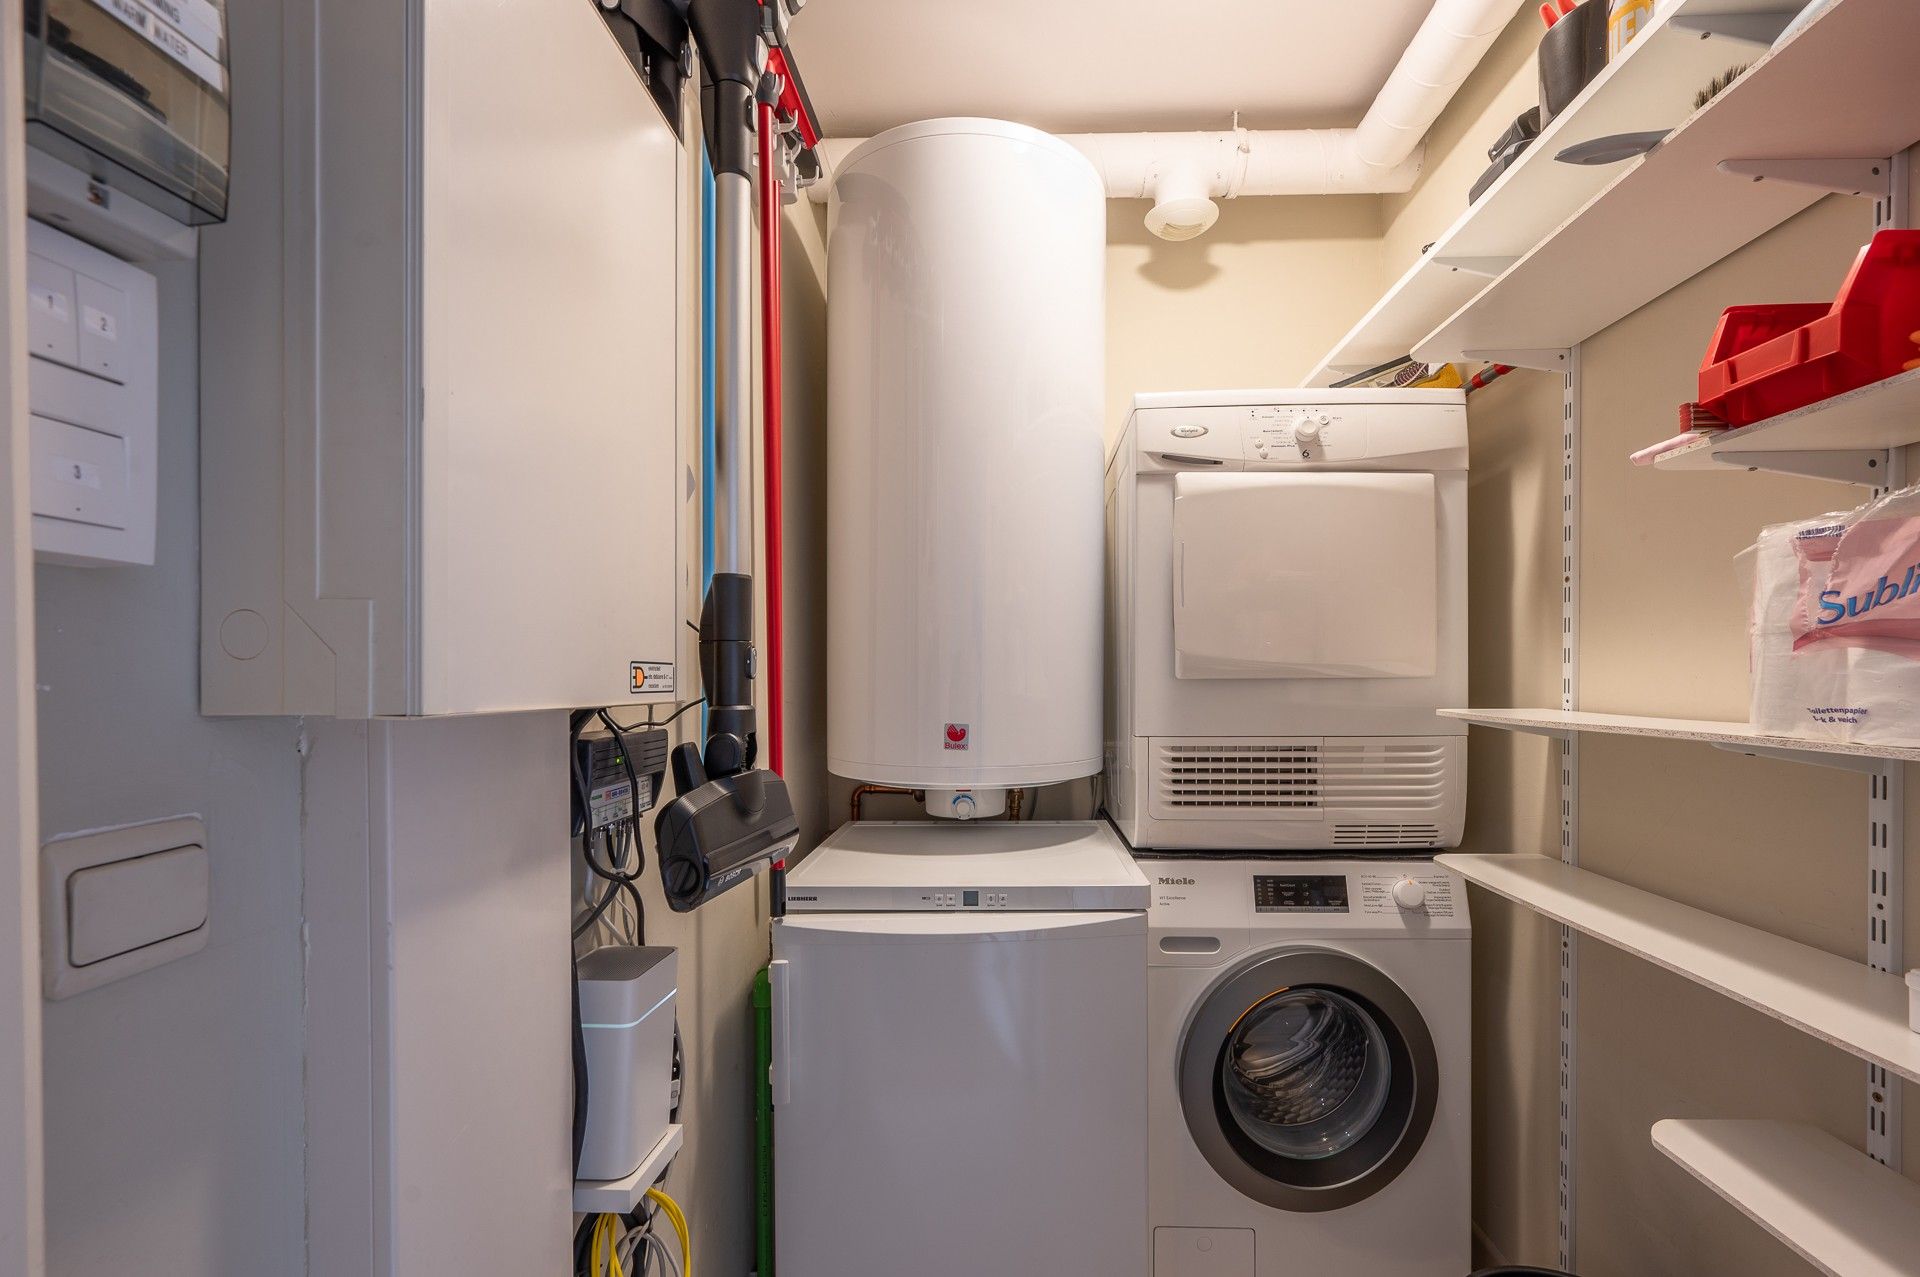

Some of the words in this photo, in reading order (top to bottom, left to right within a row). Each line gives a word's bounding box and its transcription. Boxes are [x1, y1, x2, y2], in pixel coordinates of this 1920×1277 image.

[48, 295, 53, 309] 1
[100, 316, 108, 332] 2
[74, 464, 82, 480] 3
[1158, 877, 1195, 886] Miele
